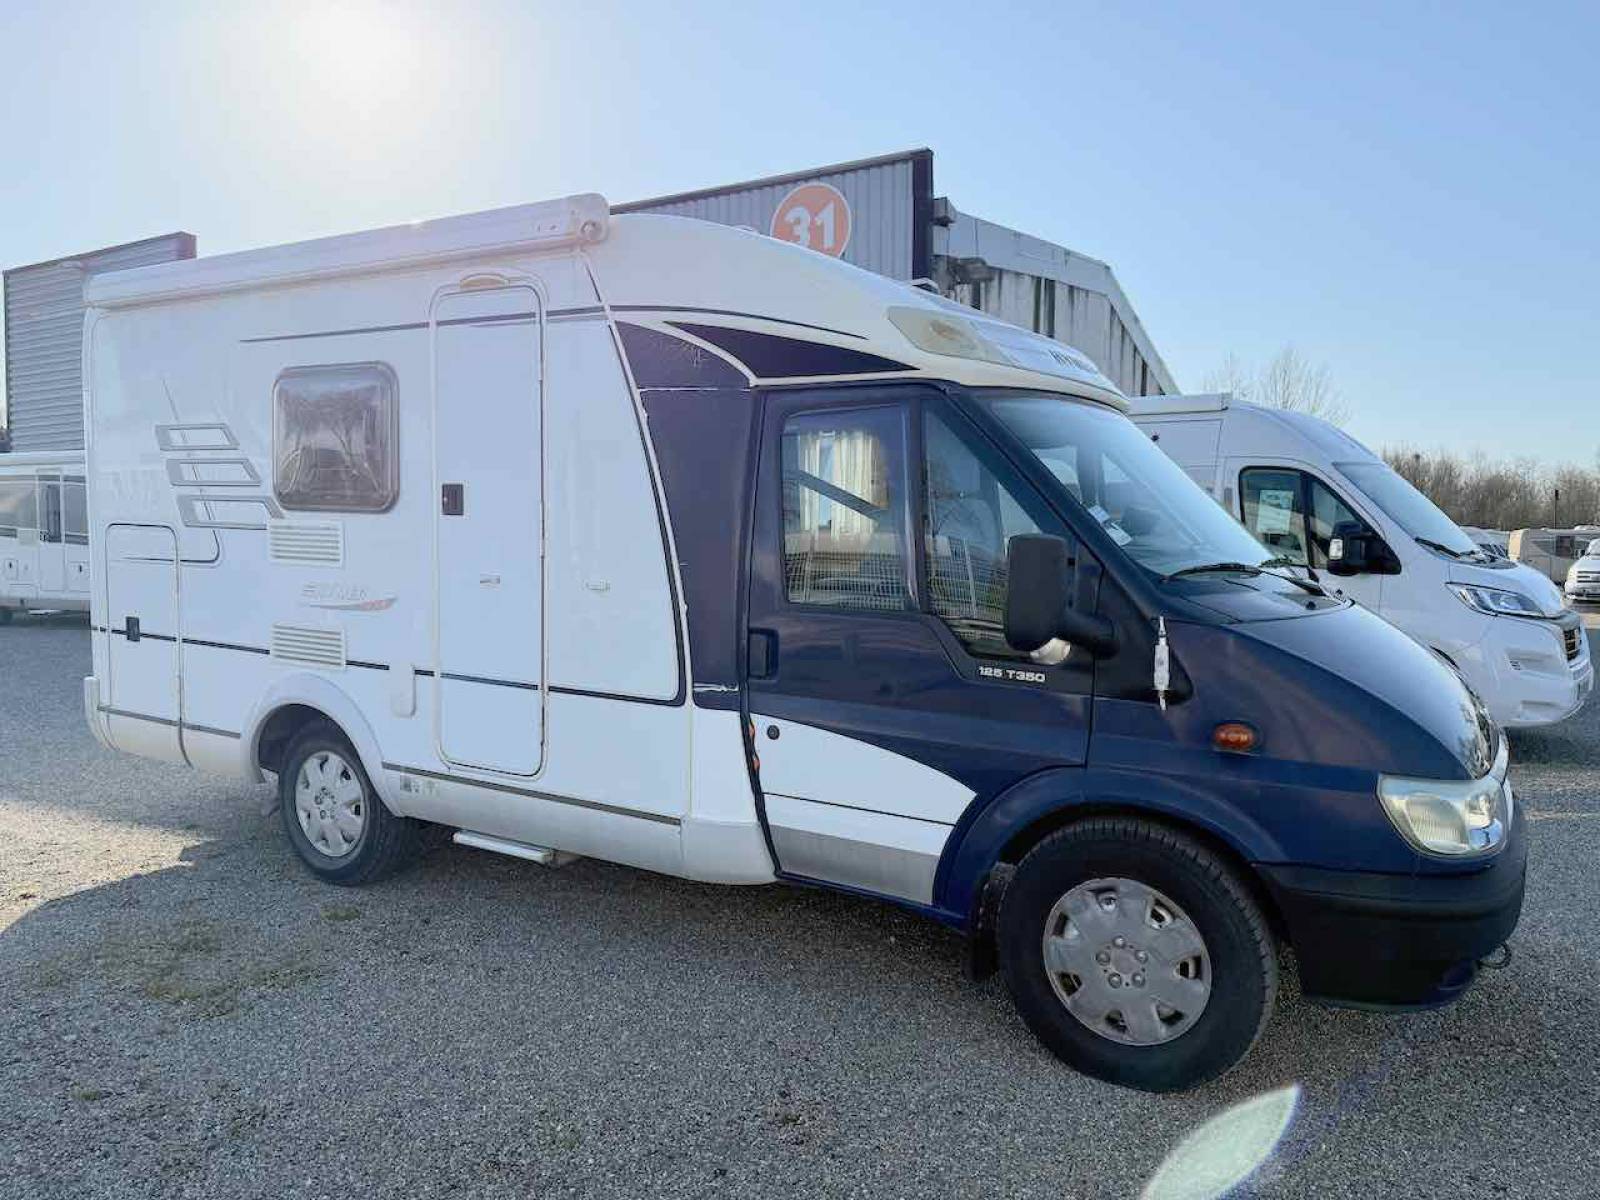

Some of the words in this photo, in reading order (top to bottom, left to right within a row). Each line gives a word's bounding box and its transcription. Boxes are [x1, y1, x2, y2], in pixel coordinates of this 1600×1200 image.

[784, 201, 834, 250] 31
[979, 666, 1002, 678] 125
[1006, 670, 1046, 682] T350
